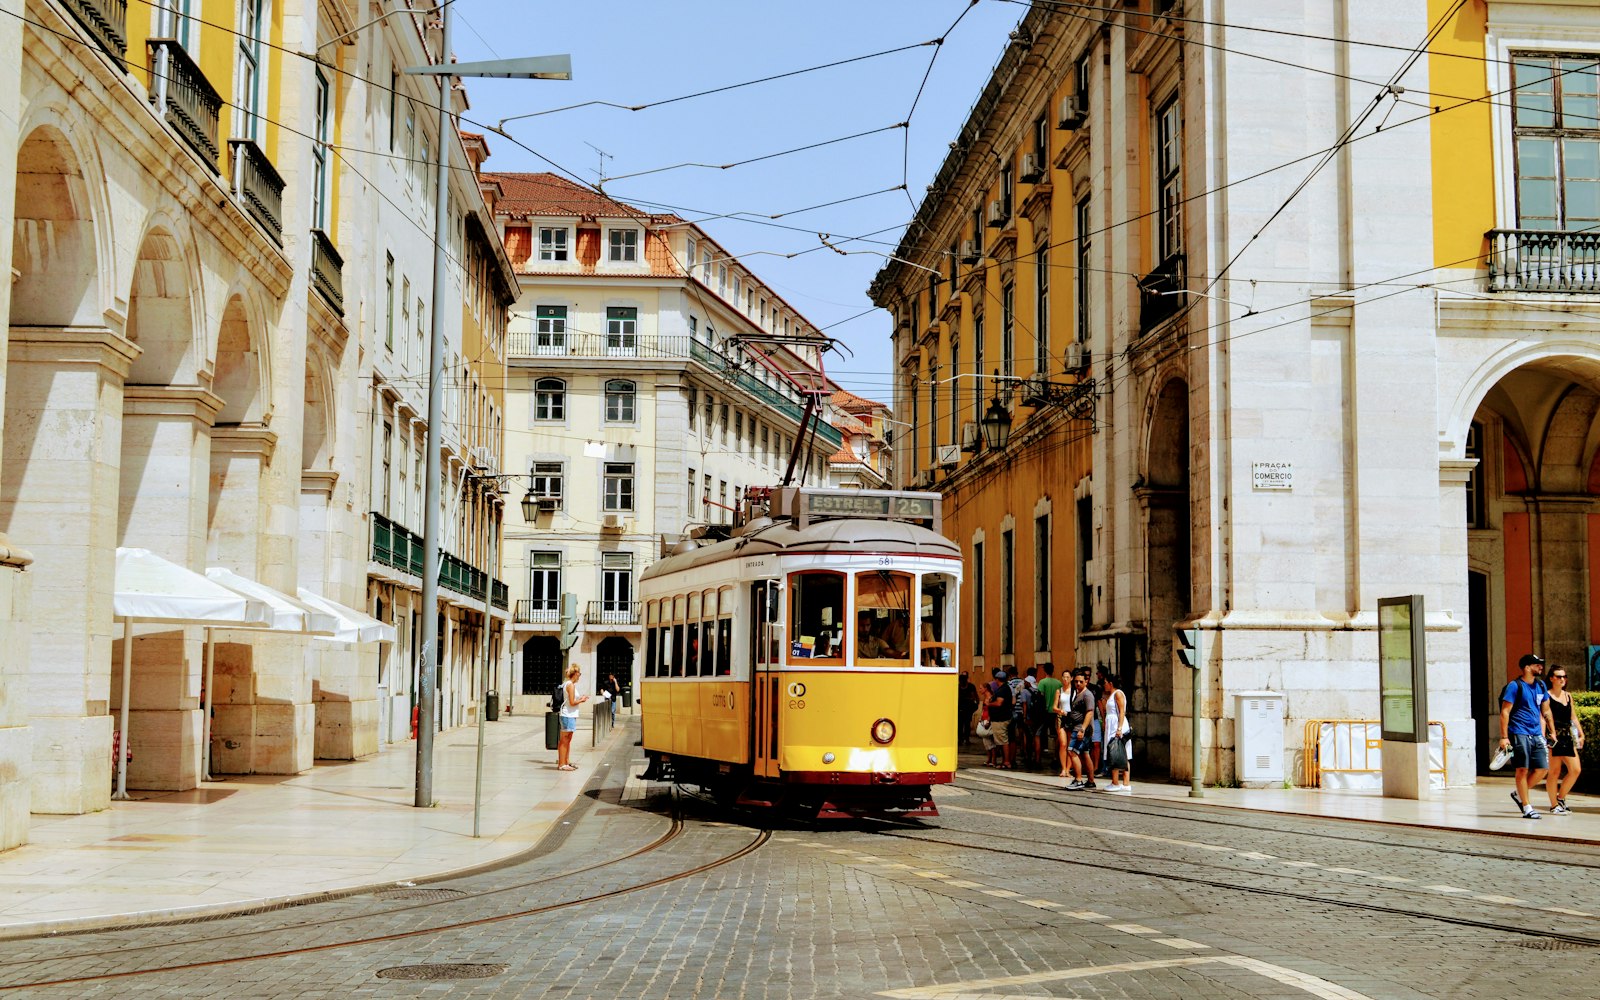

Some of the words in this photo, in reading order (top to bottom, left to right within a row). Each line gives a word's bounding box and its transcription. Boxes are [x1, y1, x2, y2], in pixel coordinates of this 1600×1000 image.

[1254, 472, 1292, 480] COMERCIO
[813, 496, 882, 510] ESTRELA
[898, 498, 921, 514] 25
[745, 560, 764, 568] ENTRADA
[878, 557, 894, 566] 581
